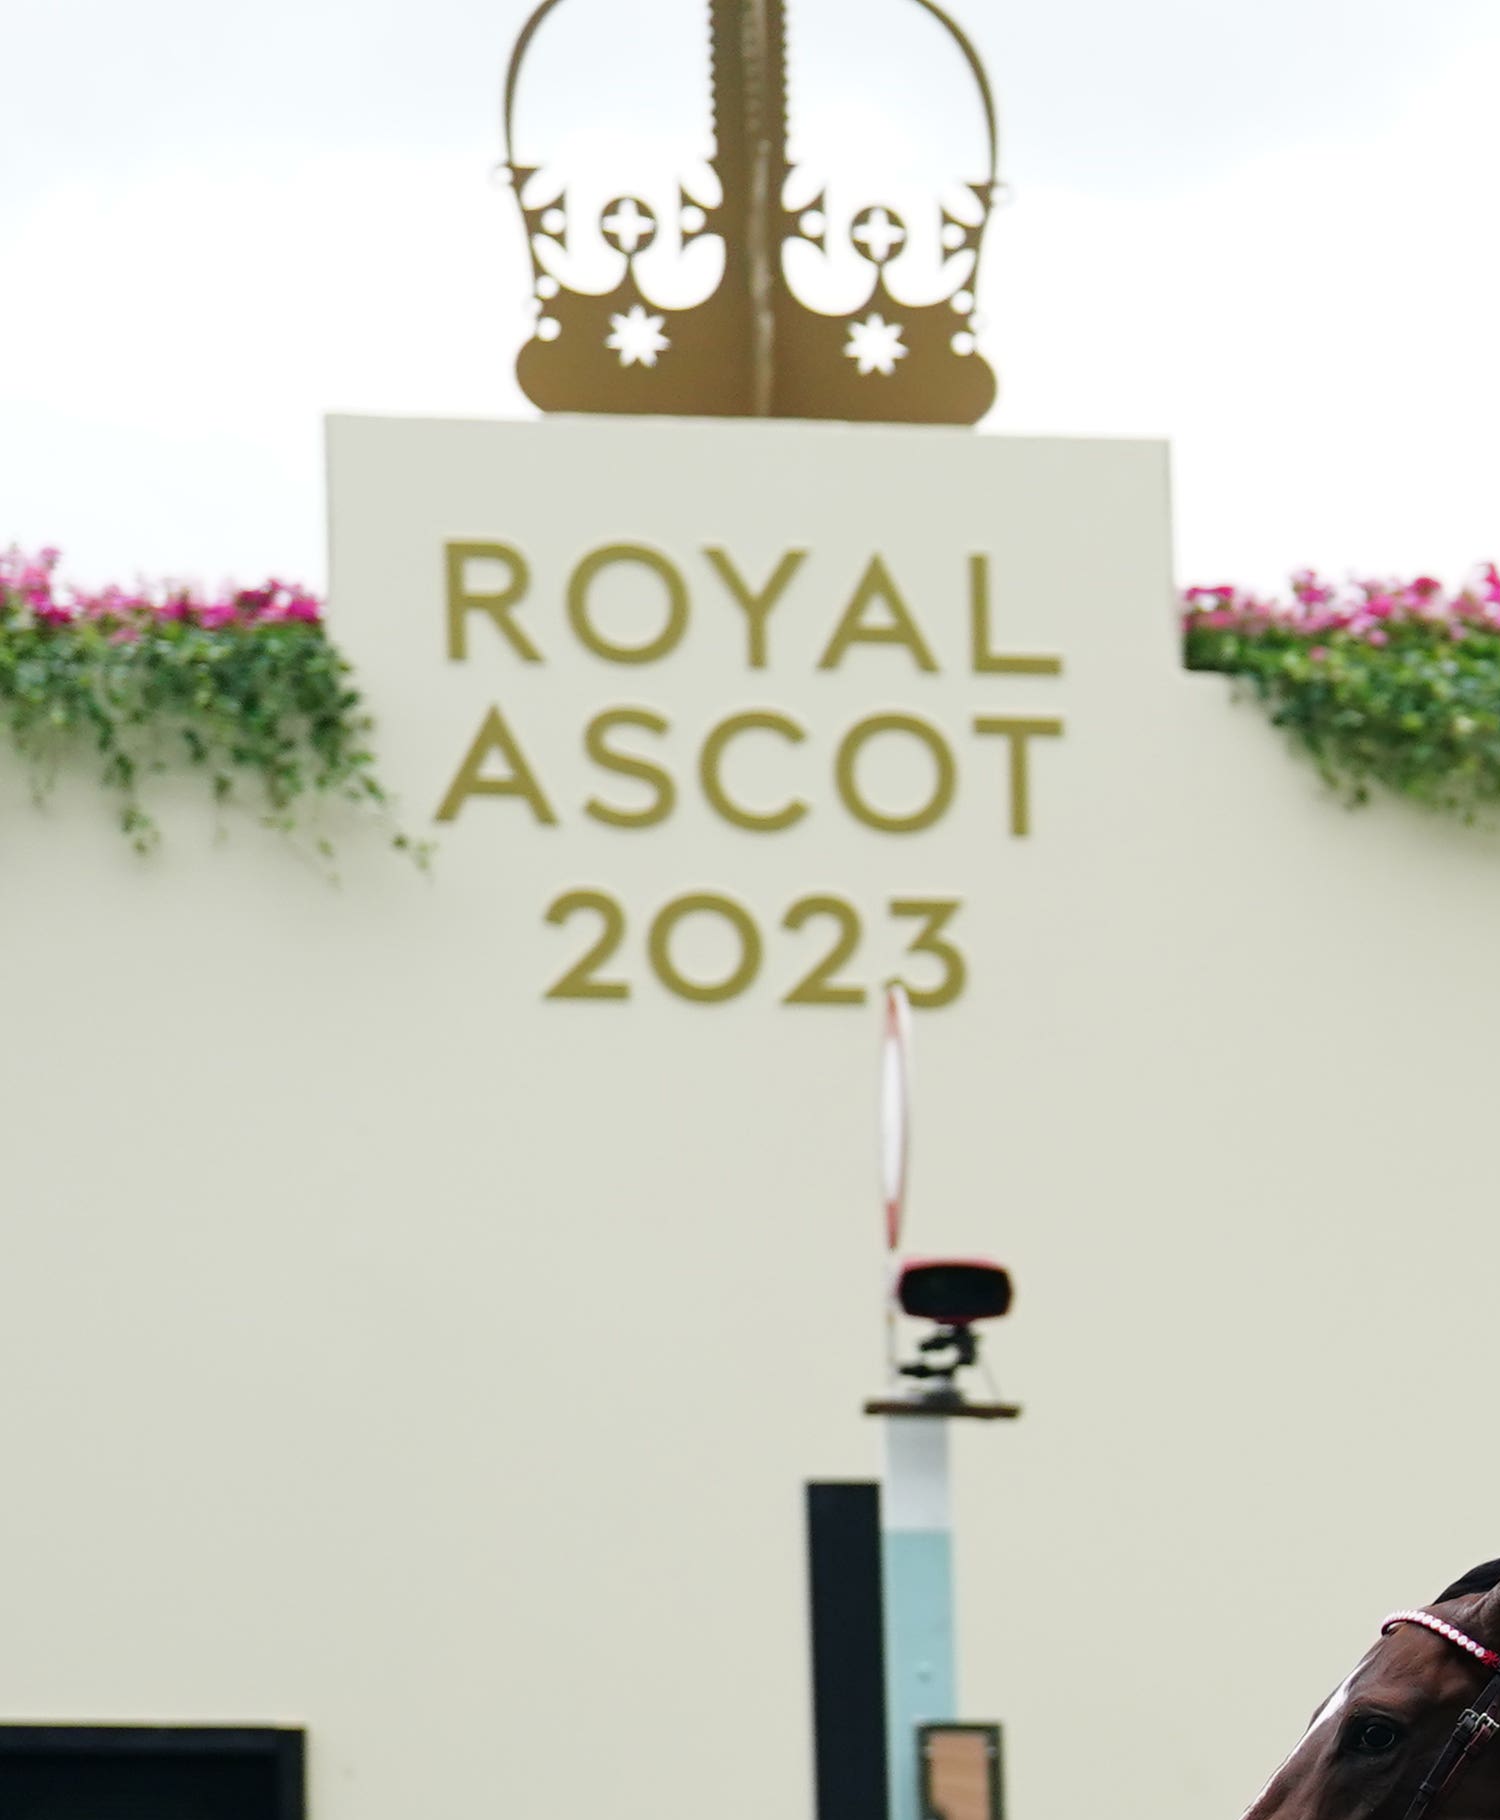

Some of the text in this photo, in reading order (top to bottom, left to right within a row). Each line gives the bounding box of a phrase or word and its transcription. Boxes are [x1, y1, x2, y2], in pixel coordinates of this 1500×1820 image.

[443, 539, 1063, 676] ROYAL
[434, 704, 1064, 838] ASCOT
[543, 888, 968, 1009] 2023
